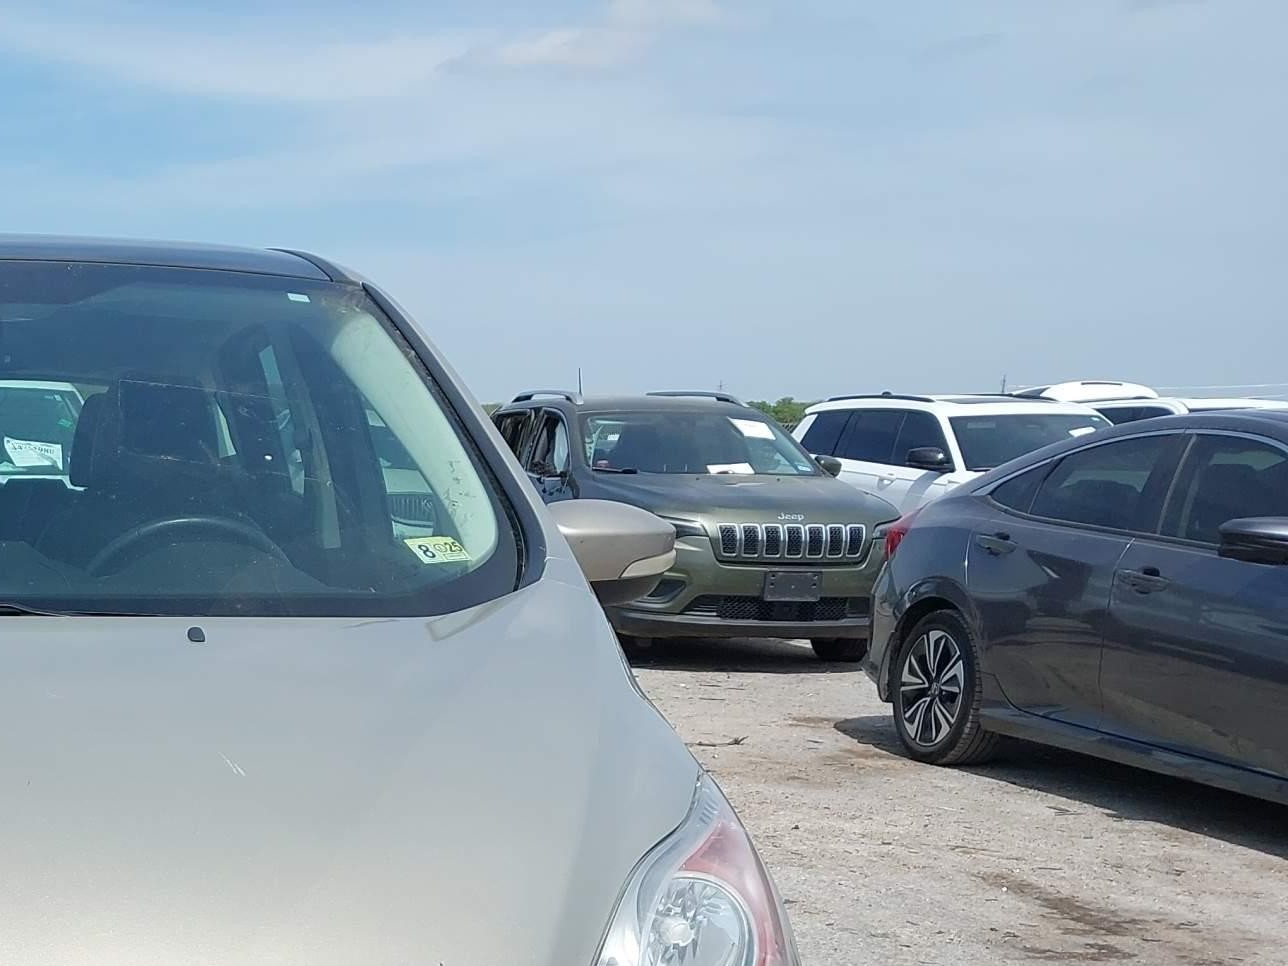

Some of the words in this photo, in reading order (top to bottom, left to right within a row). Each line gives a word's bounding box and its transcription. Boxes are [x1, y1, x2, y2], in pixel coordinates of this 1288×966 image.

[777, 512, 805, 521] Jeep
[418, 544, 436, 558] 8
[444, 541, 463, 553] 25
